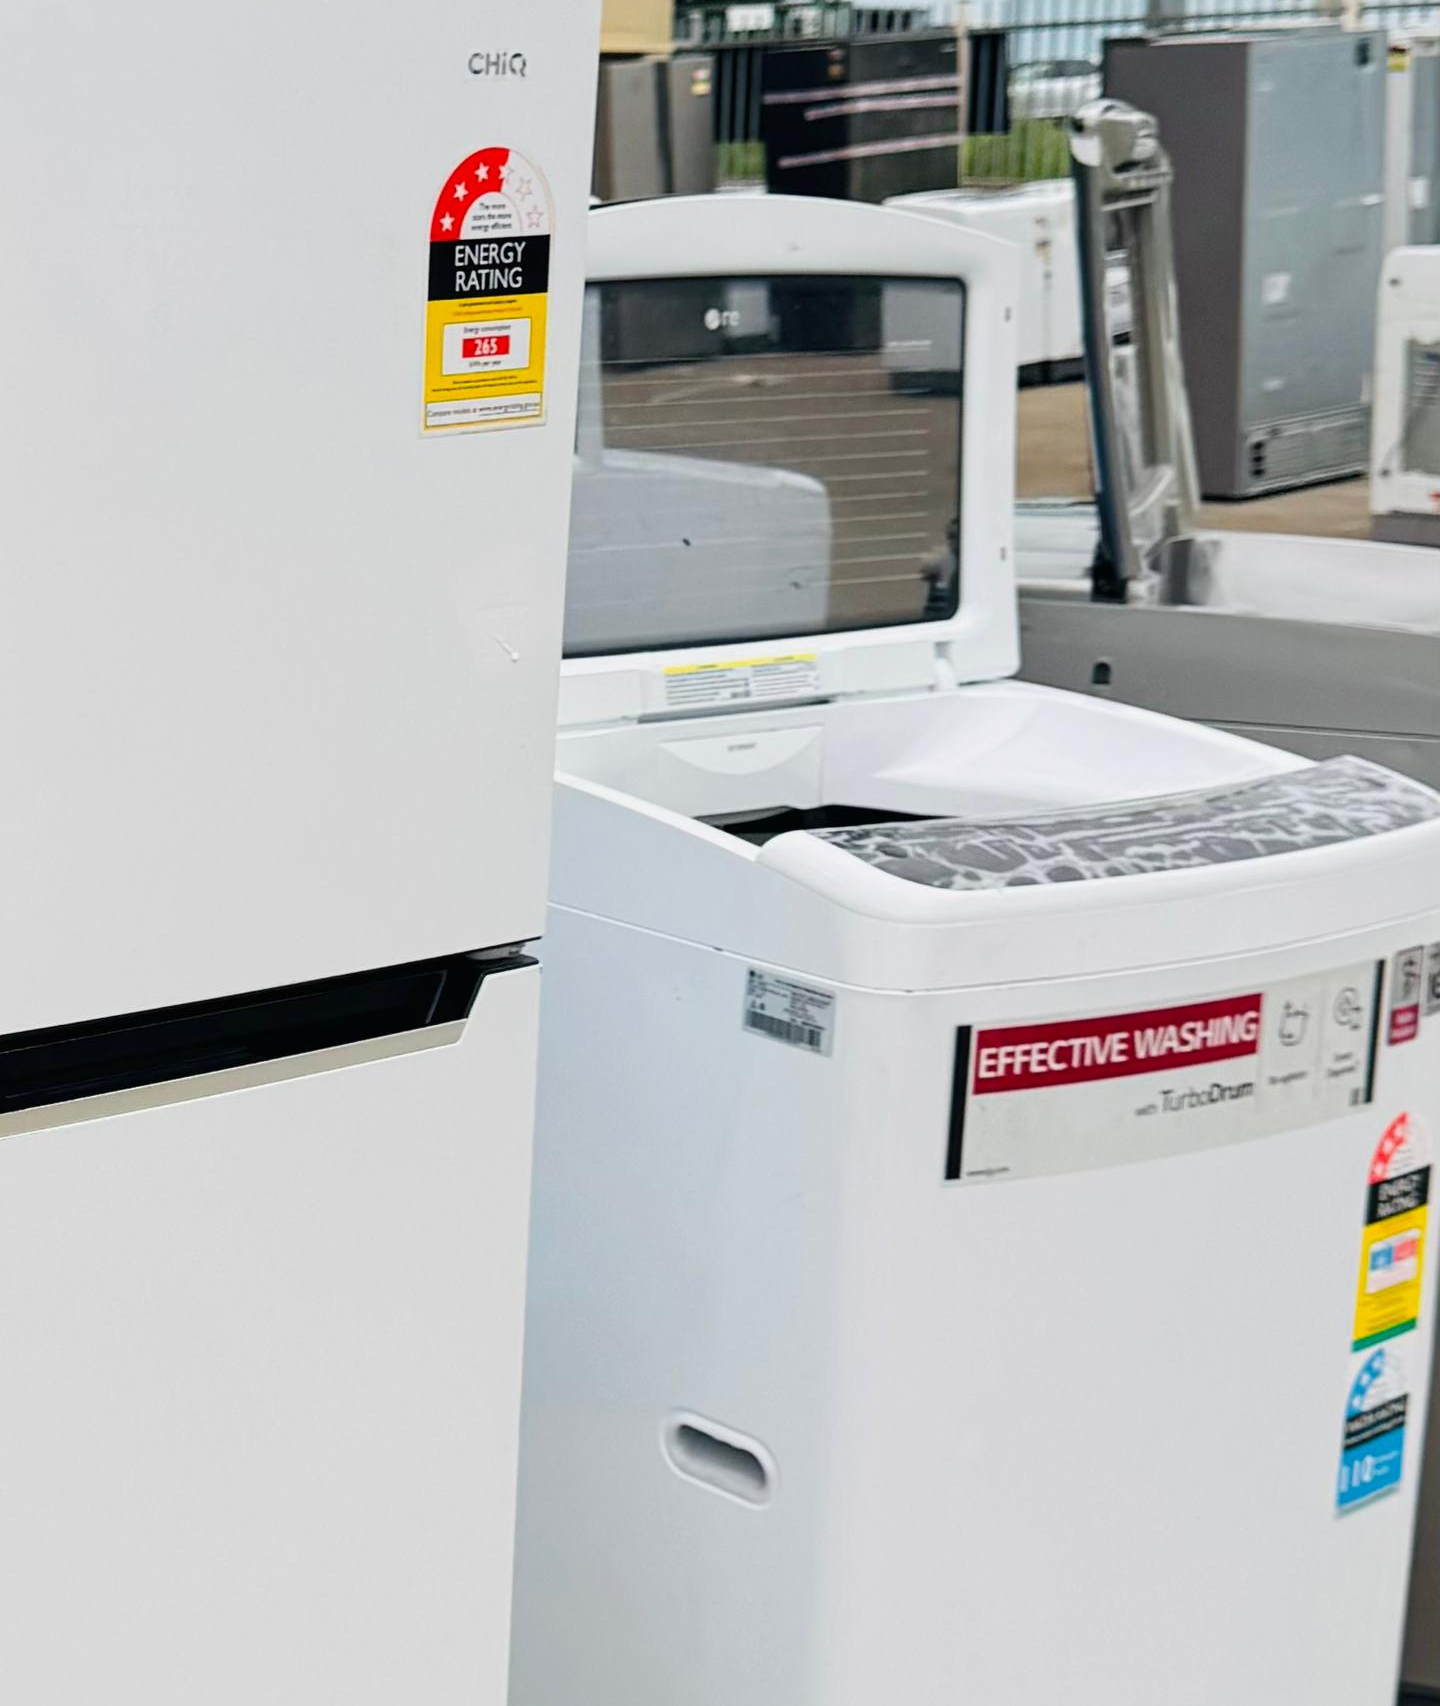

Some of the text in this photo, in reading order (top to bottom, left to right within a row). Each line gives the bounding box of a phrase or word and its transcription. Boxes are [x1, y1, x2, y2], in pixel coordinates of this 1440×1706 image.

[468, 51, 527, 77] CHiQ
[454, 241, 526, 267] ENERGY
[455, 267, 523, 292] RATING
[474, 338, 498, 356] 265
[978, 1011, 1258, 1079] EFFECTIVE WASHING
[1160, 1082, 1254, 1112] TurboDrum
